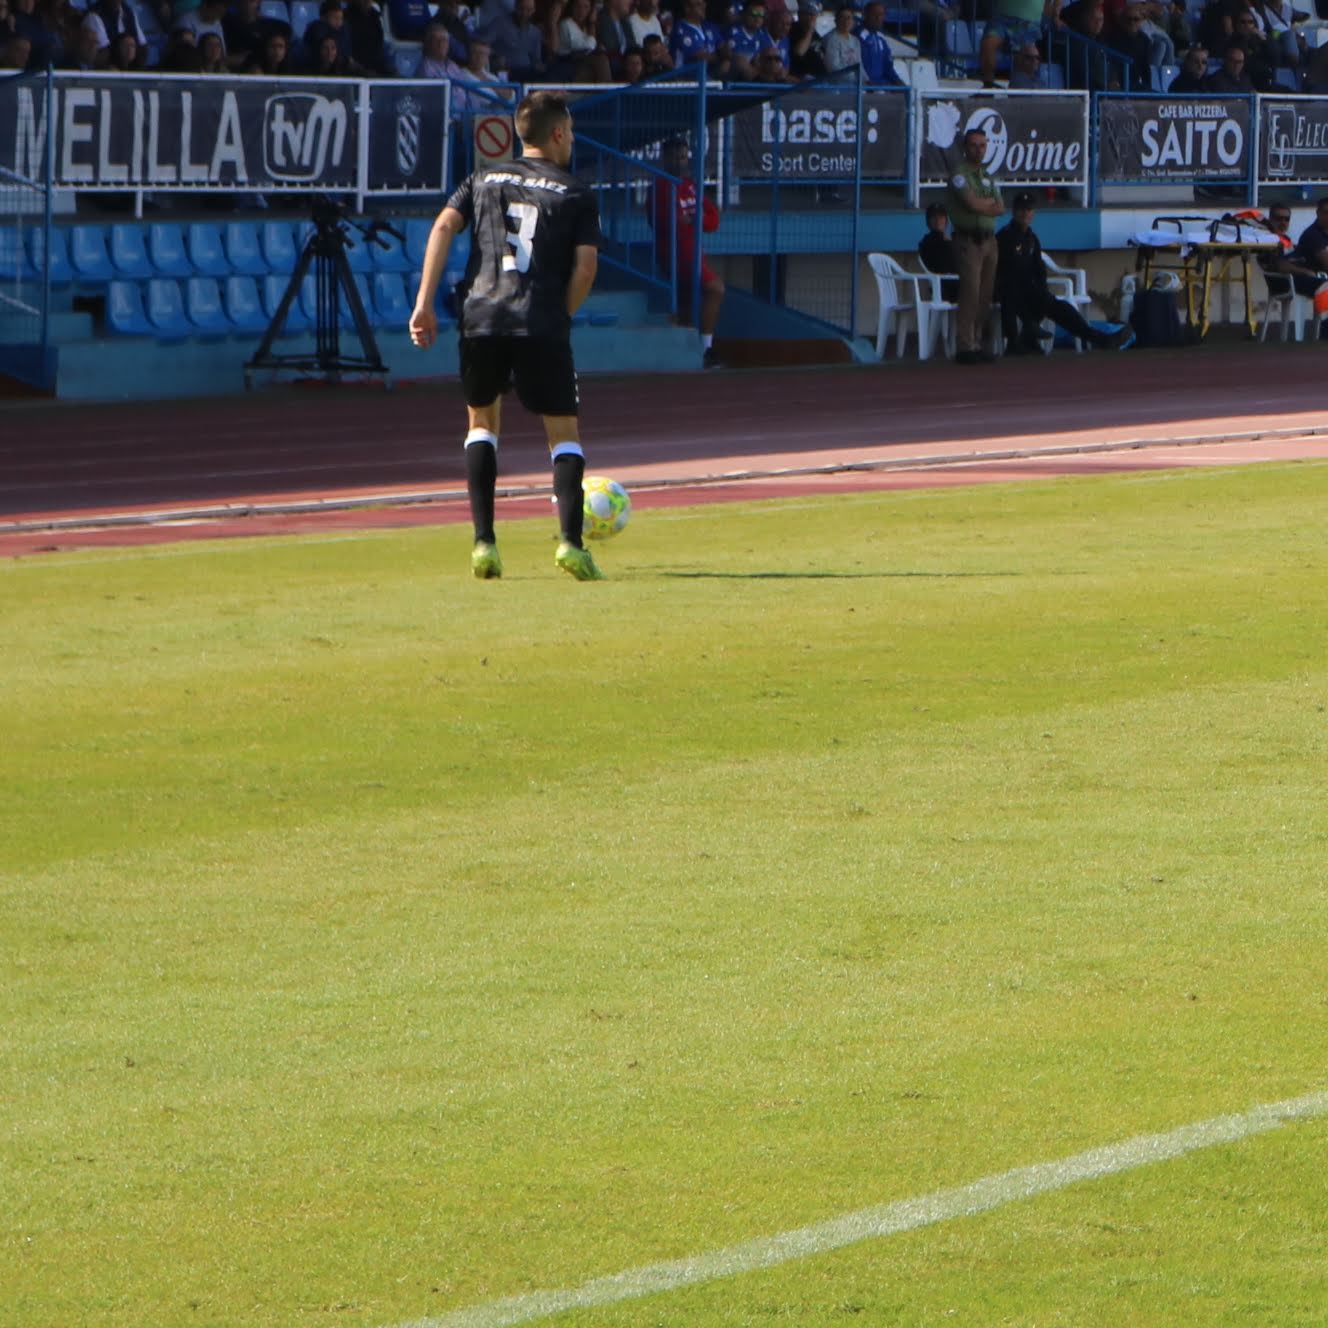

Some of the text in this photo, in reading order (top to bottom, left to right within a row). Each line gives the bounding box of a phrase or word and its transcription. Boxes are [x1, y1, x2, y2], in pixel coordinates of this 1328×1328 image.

[15, 86, 249, 183] MELILLA
[1178, 105, 1194, 119] BAR
[1195, 105, 1228, 119] PIZZERIA
[1140, 119, 1243, 168] SAITO
[502, 201, 538, 274] 3
